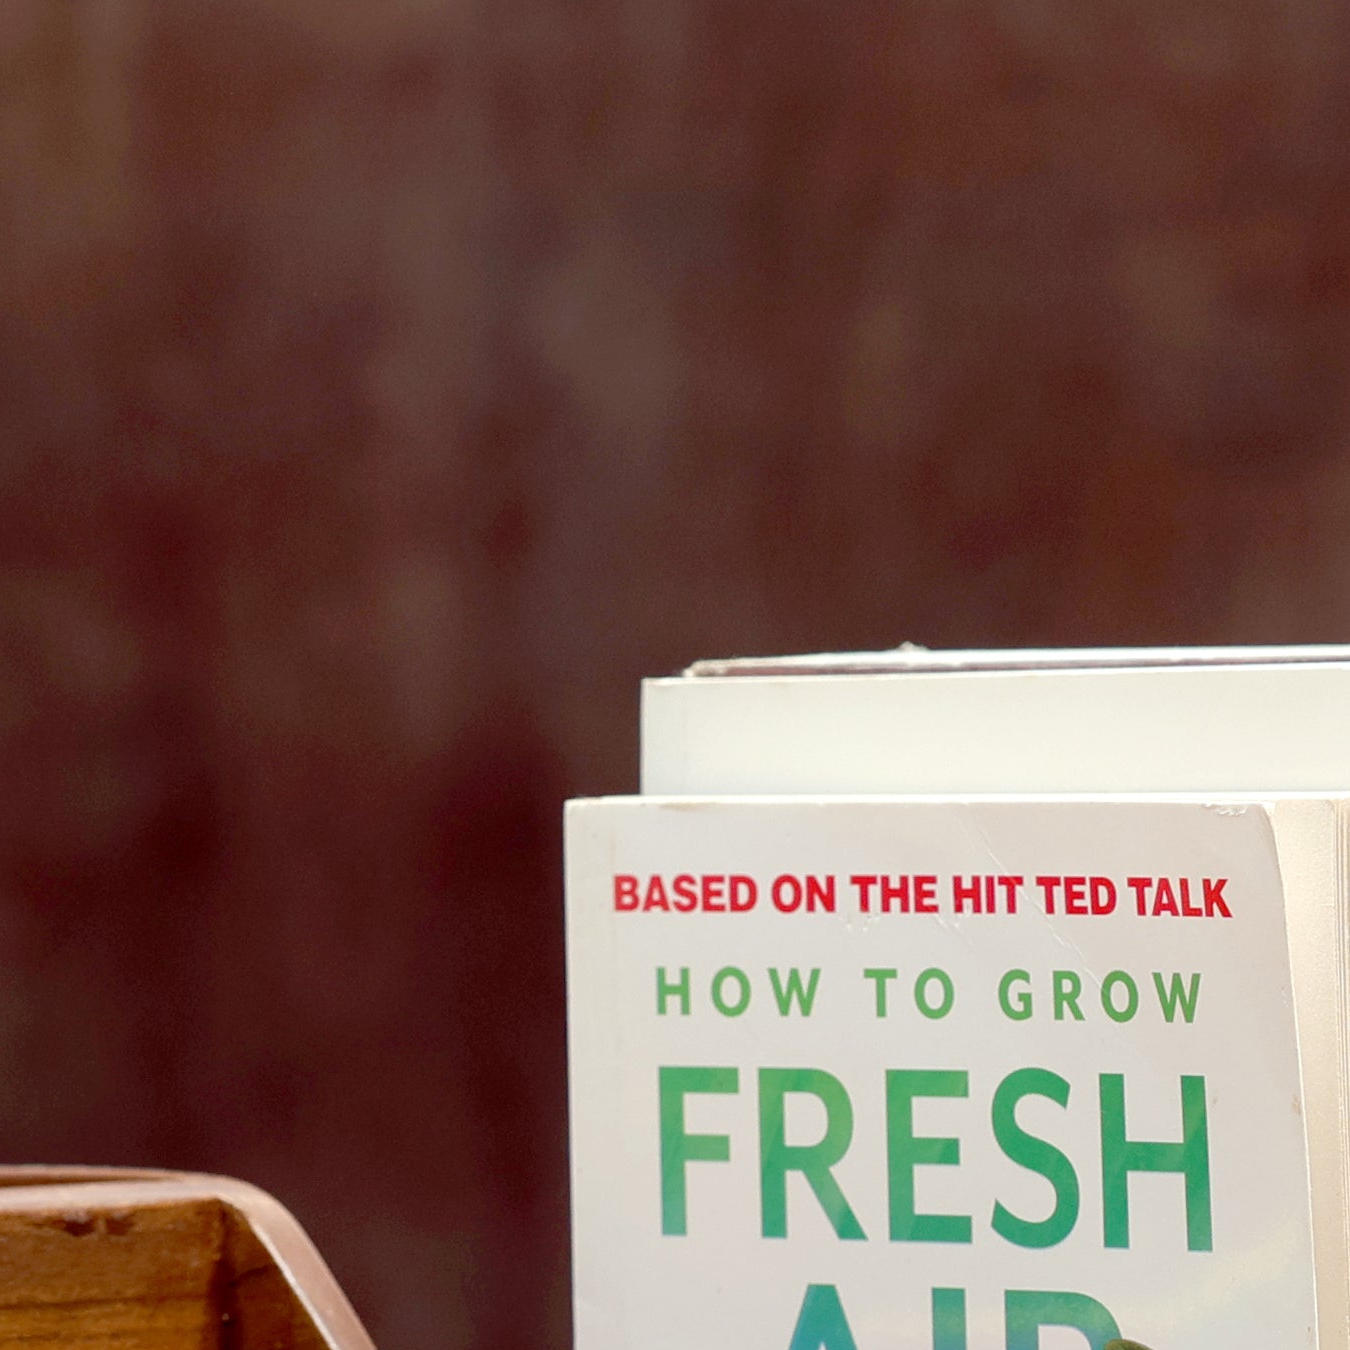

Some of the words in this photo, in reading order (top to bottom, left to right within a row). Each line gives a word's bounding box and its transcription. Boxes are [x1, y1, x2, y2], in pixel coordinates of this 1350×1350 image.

[613, 874, 758, 913] BASED
[771, 874, 836, 914] ON
[850, 875, 940, 915] THE
[953, 875, 1023, 915] HIT
[1035, 876, 1118, 916] TED
[1127, 876, 1234, 919] TALK
[655, 966, 822, 1018] HOW
[863, 967, 955, 1020] TO
[998, 969, 1202, 1024] GROW
[658, 1065, 1213, 1252] FRESH
